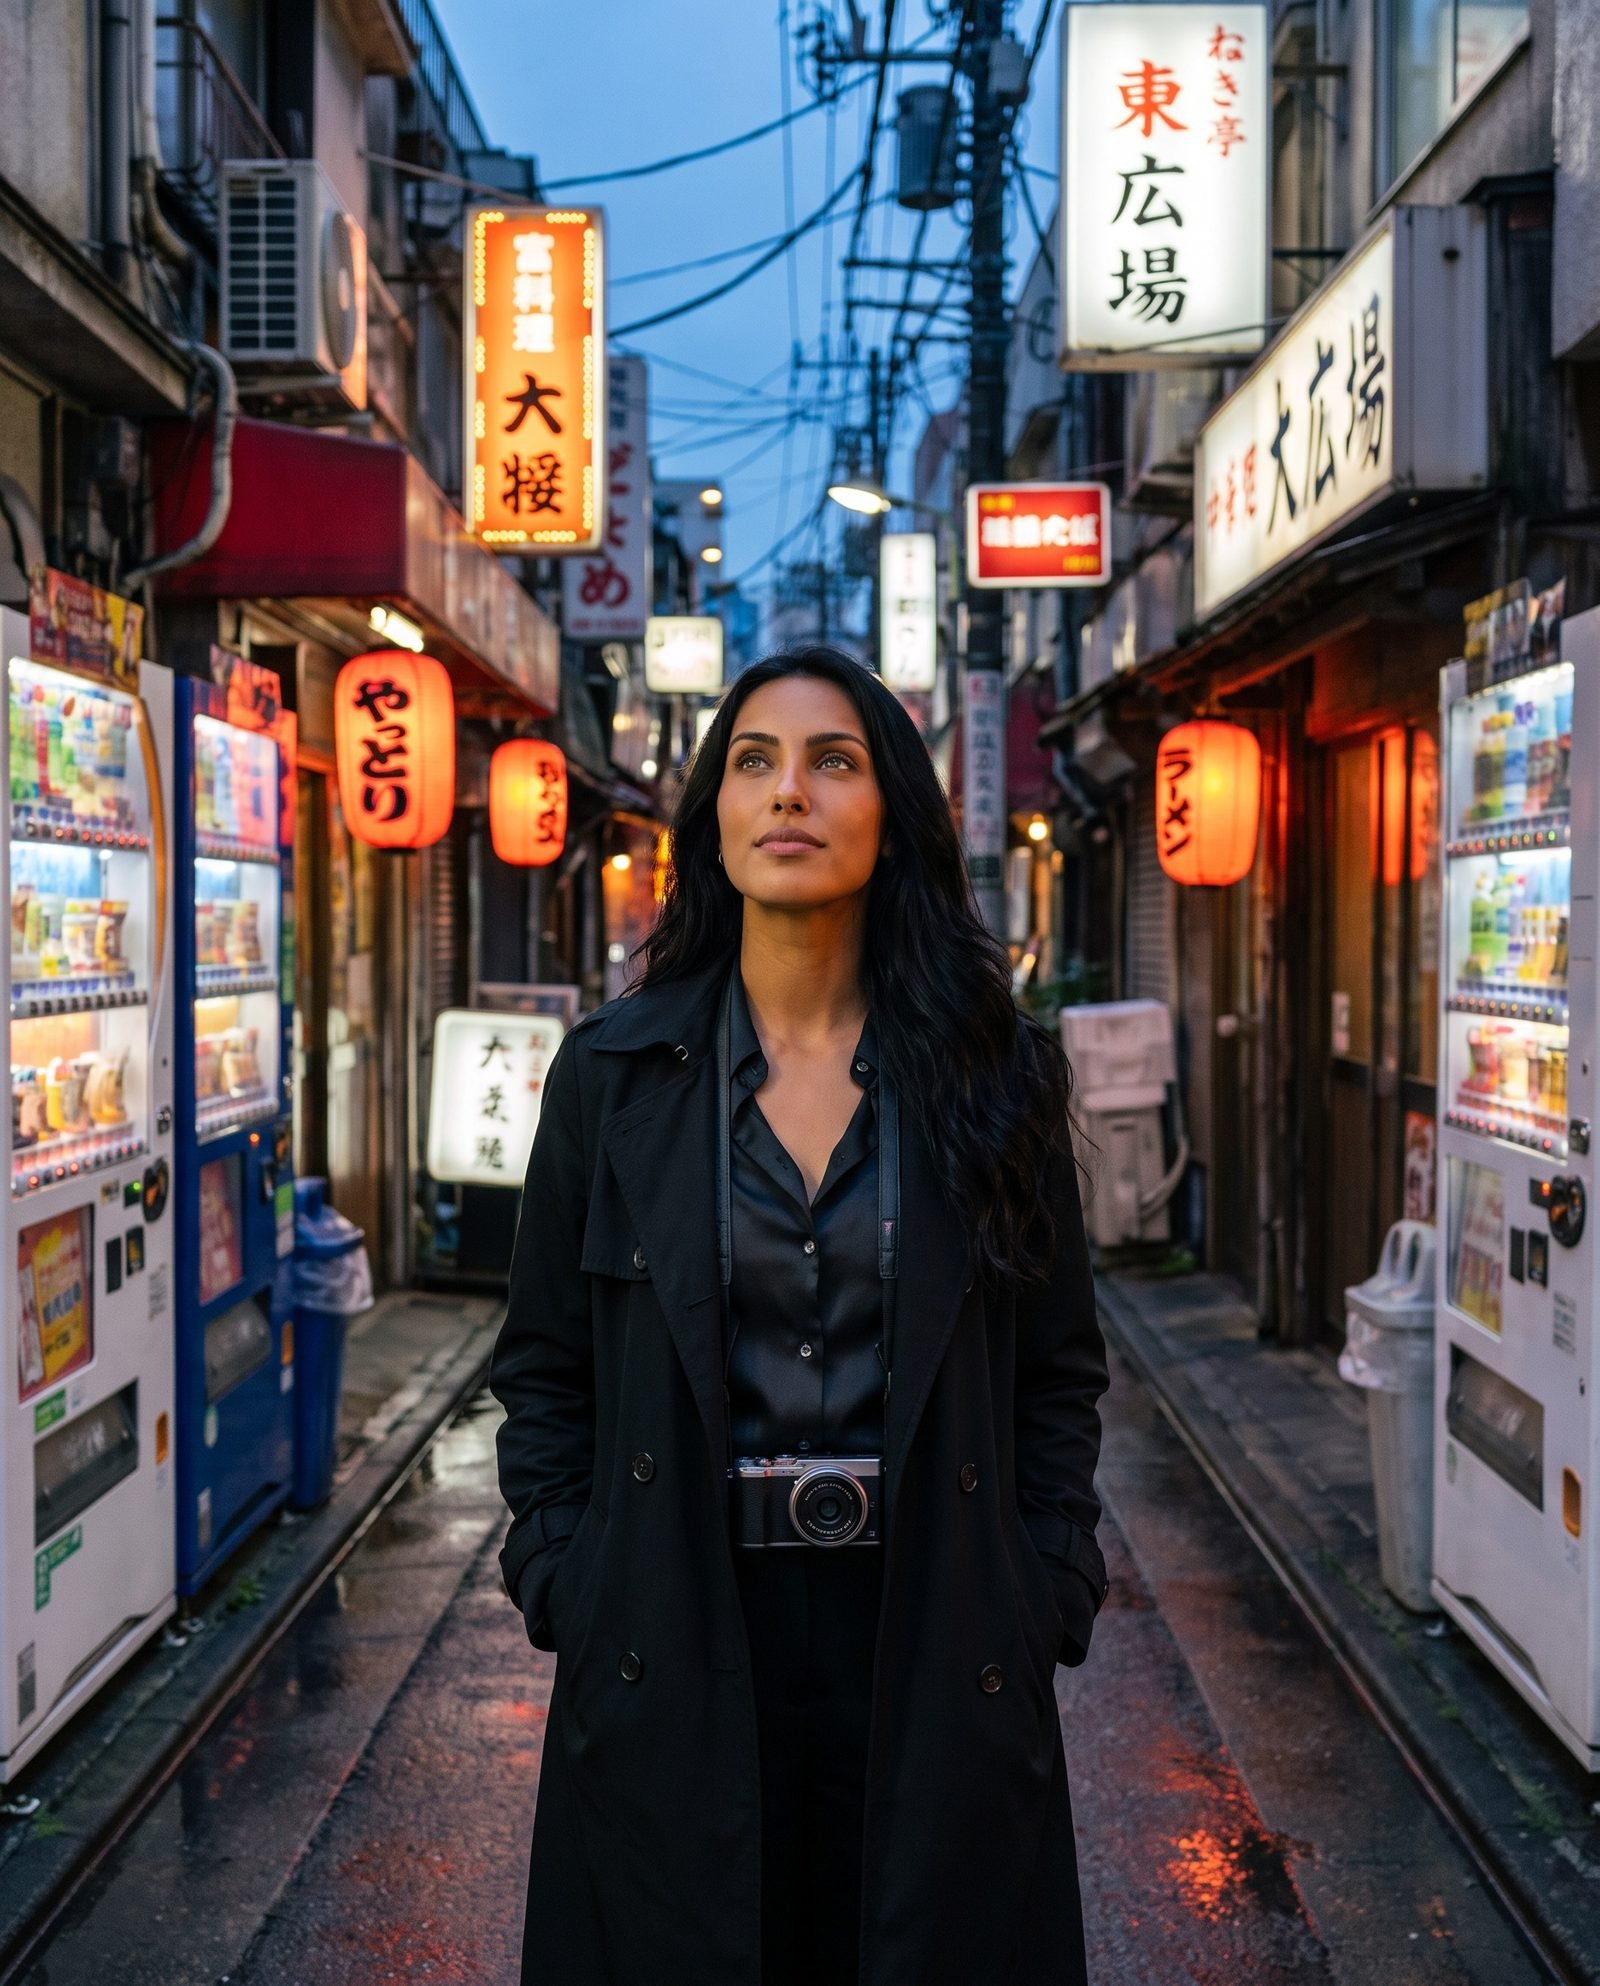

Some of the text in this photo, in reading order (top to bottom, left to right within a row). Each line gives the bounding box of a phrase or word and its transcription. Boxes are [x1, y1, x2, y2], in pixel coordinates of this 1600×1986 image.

[1108, 58, 1190, 324] 東広場
[1268, 292, 1386, 536] 大広場
[1164, 749, 1191, 857] ラーメン
